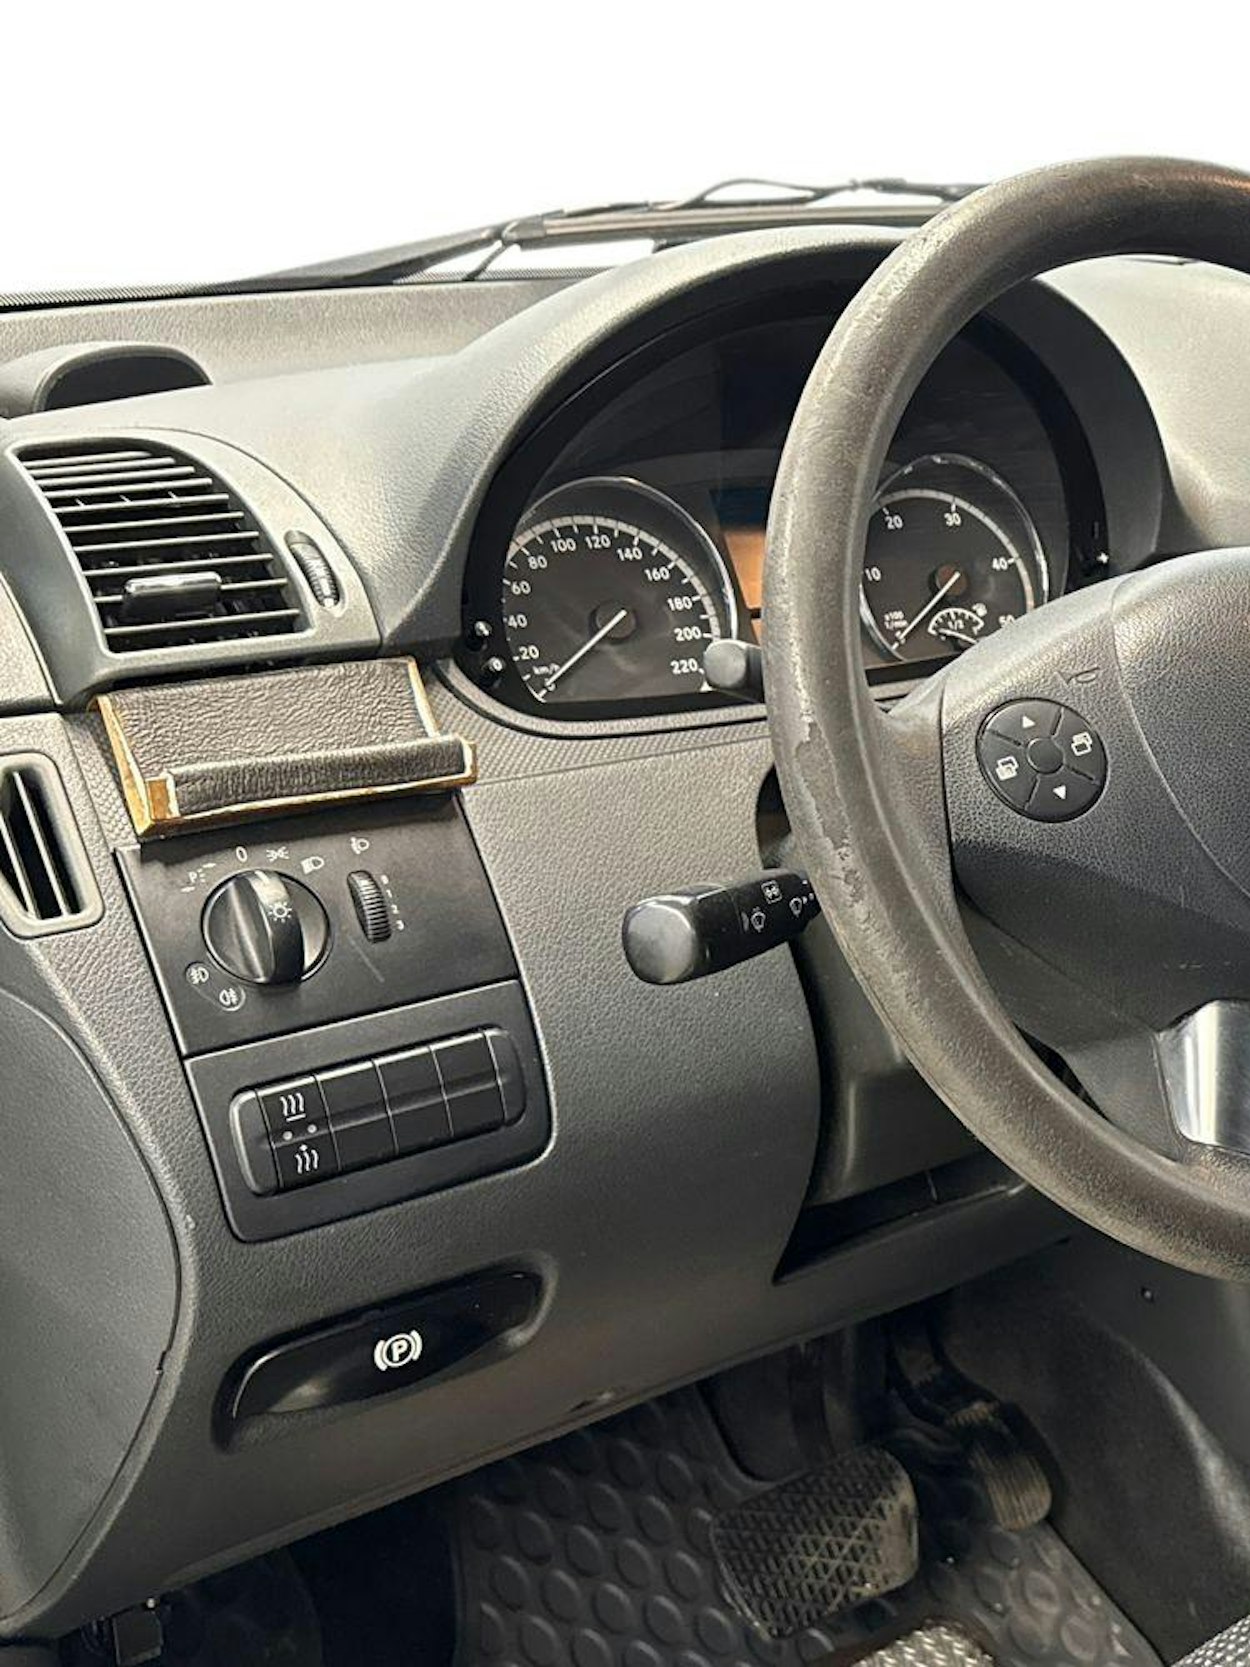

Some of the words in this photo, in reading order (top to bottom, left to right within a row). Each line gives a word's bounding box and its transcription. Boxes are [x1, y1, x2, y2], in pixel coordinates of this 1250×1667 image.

[885, 515, 903, 530] 20
[944, 513, 961, 526] 30
[550, 538, 576, 553] 100
[585, 536, 611, 549] 120
[616, 548, 643, 561] 140
[527, 556, 547, 569] 80
[992, 558, 1008, 571] 40
[644, 568, 670, 581] 160
[864, 567, 881, 581] 10
[511, 581, 531, 594] 60
[667, 597, 692, 611] 180
[508, 615, 527, 629] 40
[674, 626, 701, 641] 200
[519, 646, 539, 660] 20
[670, 659, 698, 674] 220
[235, 846, 248, 862] 0
[391, 1339, 409, 1362] P
